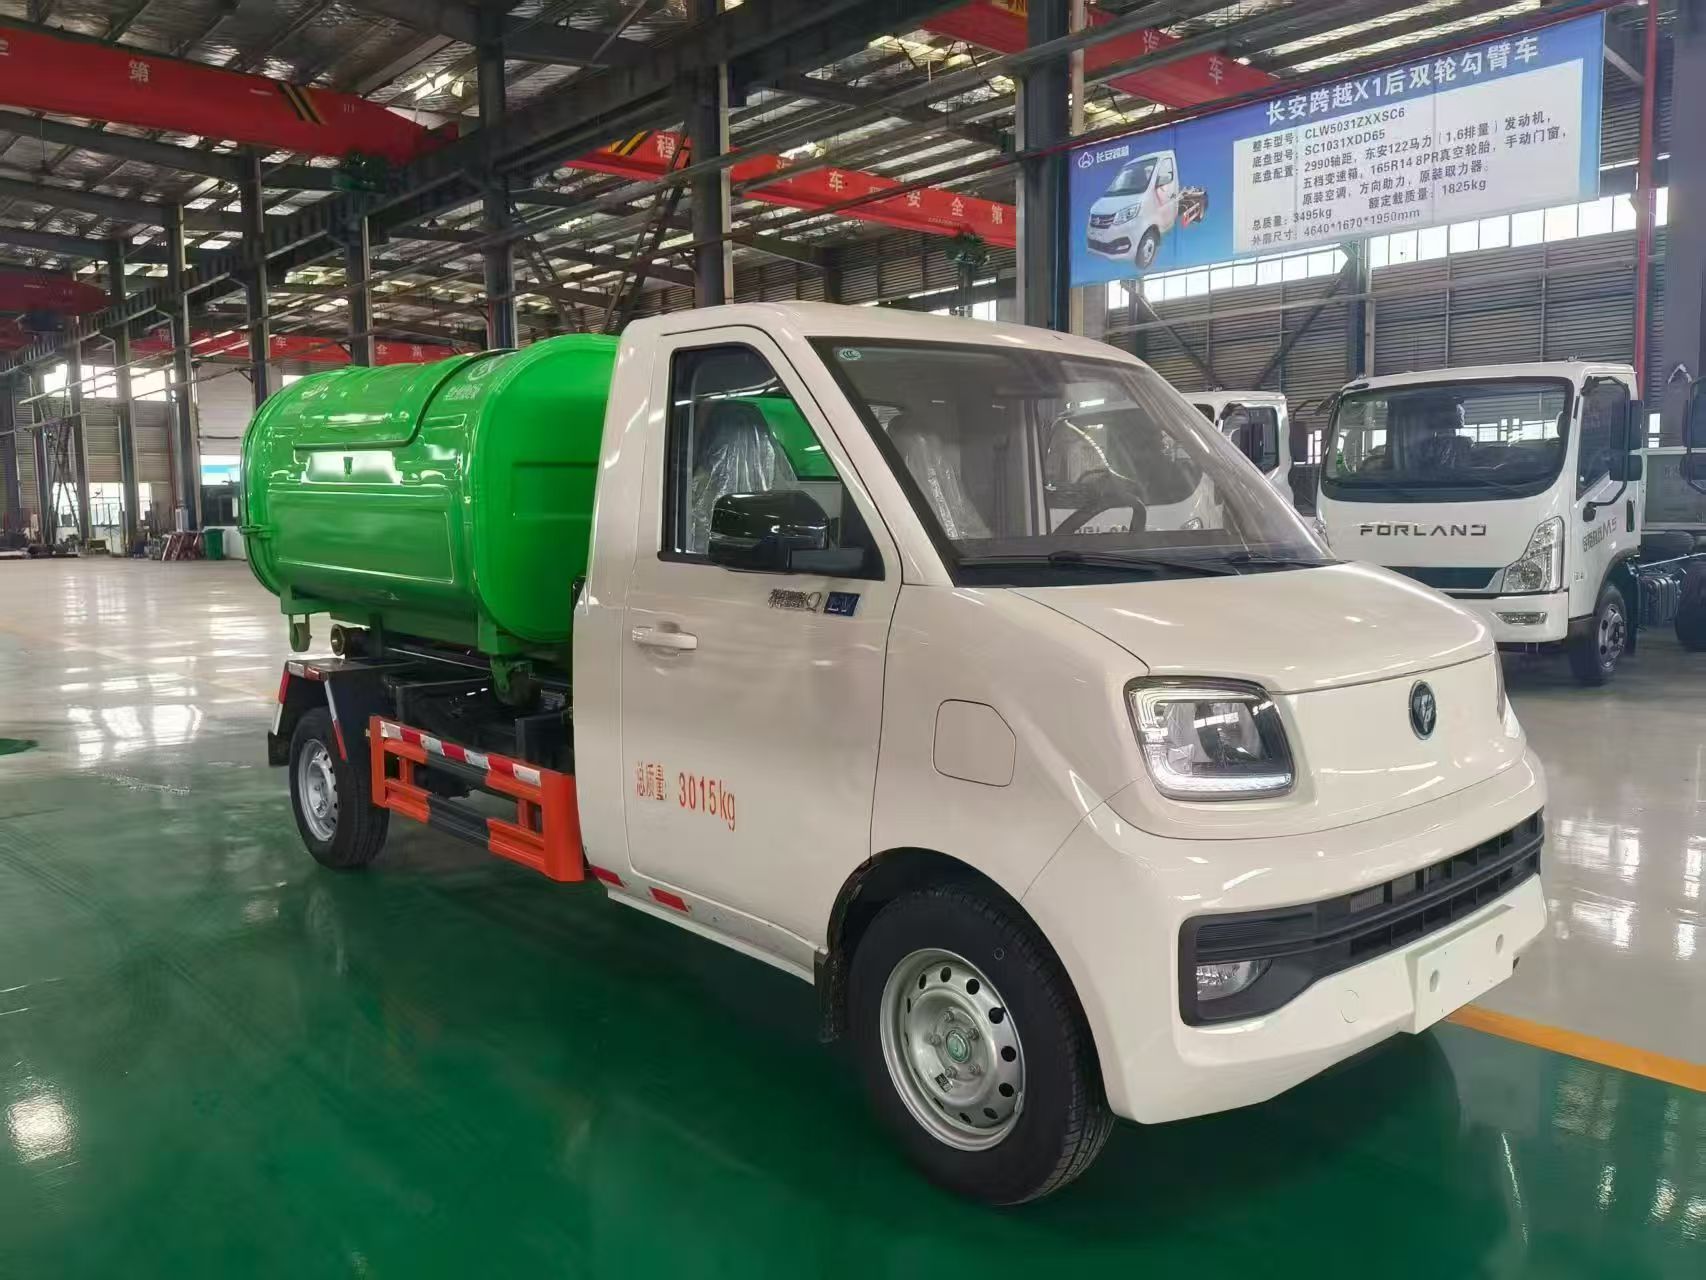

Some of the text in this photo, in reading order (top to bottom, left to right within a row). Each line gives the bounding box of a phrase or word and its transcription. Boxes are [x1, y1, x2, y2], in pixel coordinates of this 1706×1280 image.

[1266, 36, 1539, 126] 长安跨越X1后双轮勾臂车
[828, 170, 843, 192] 车
[951, 197, 964, 217] 全
[1360, 524, 1486, 536] FORLAND
[679, 772, 735, 831] 3015kg
